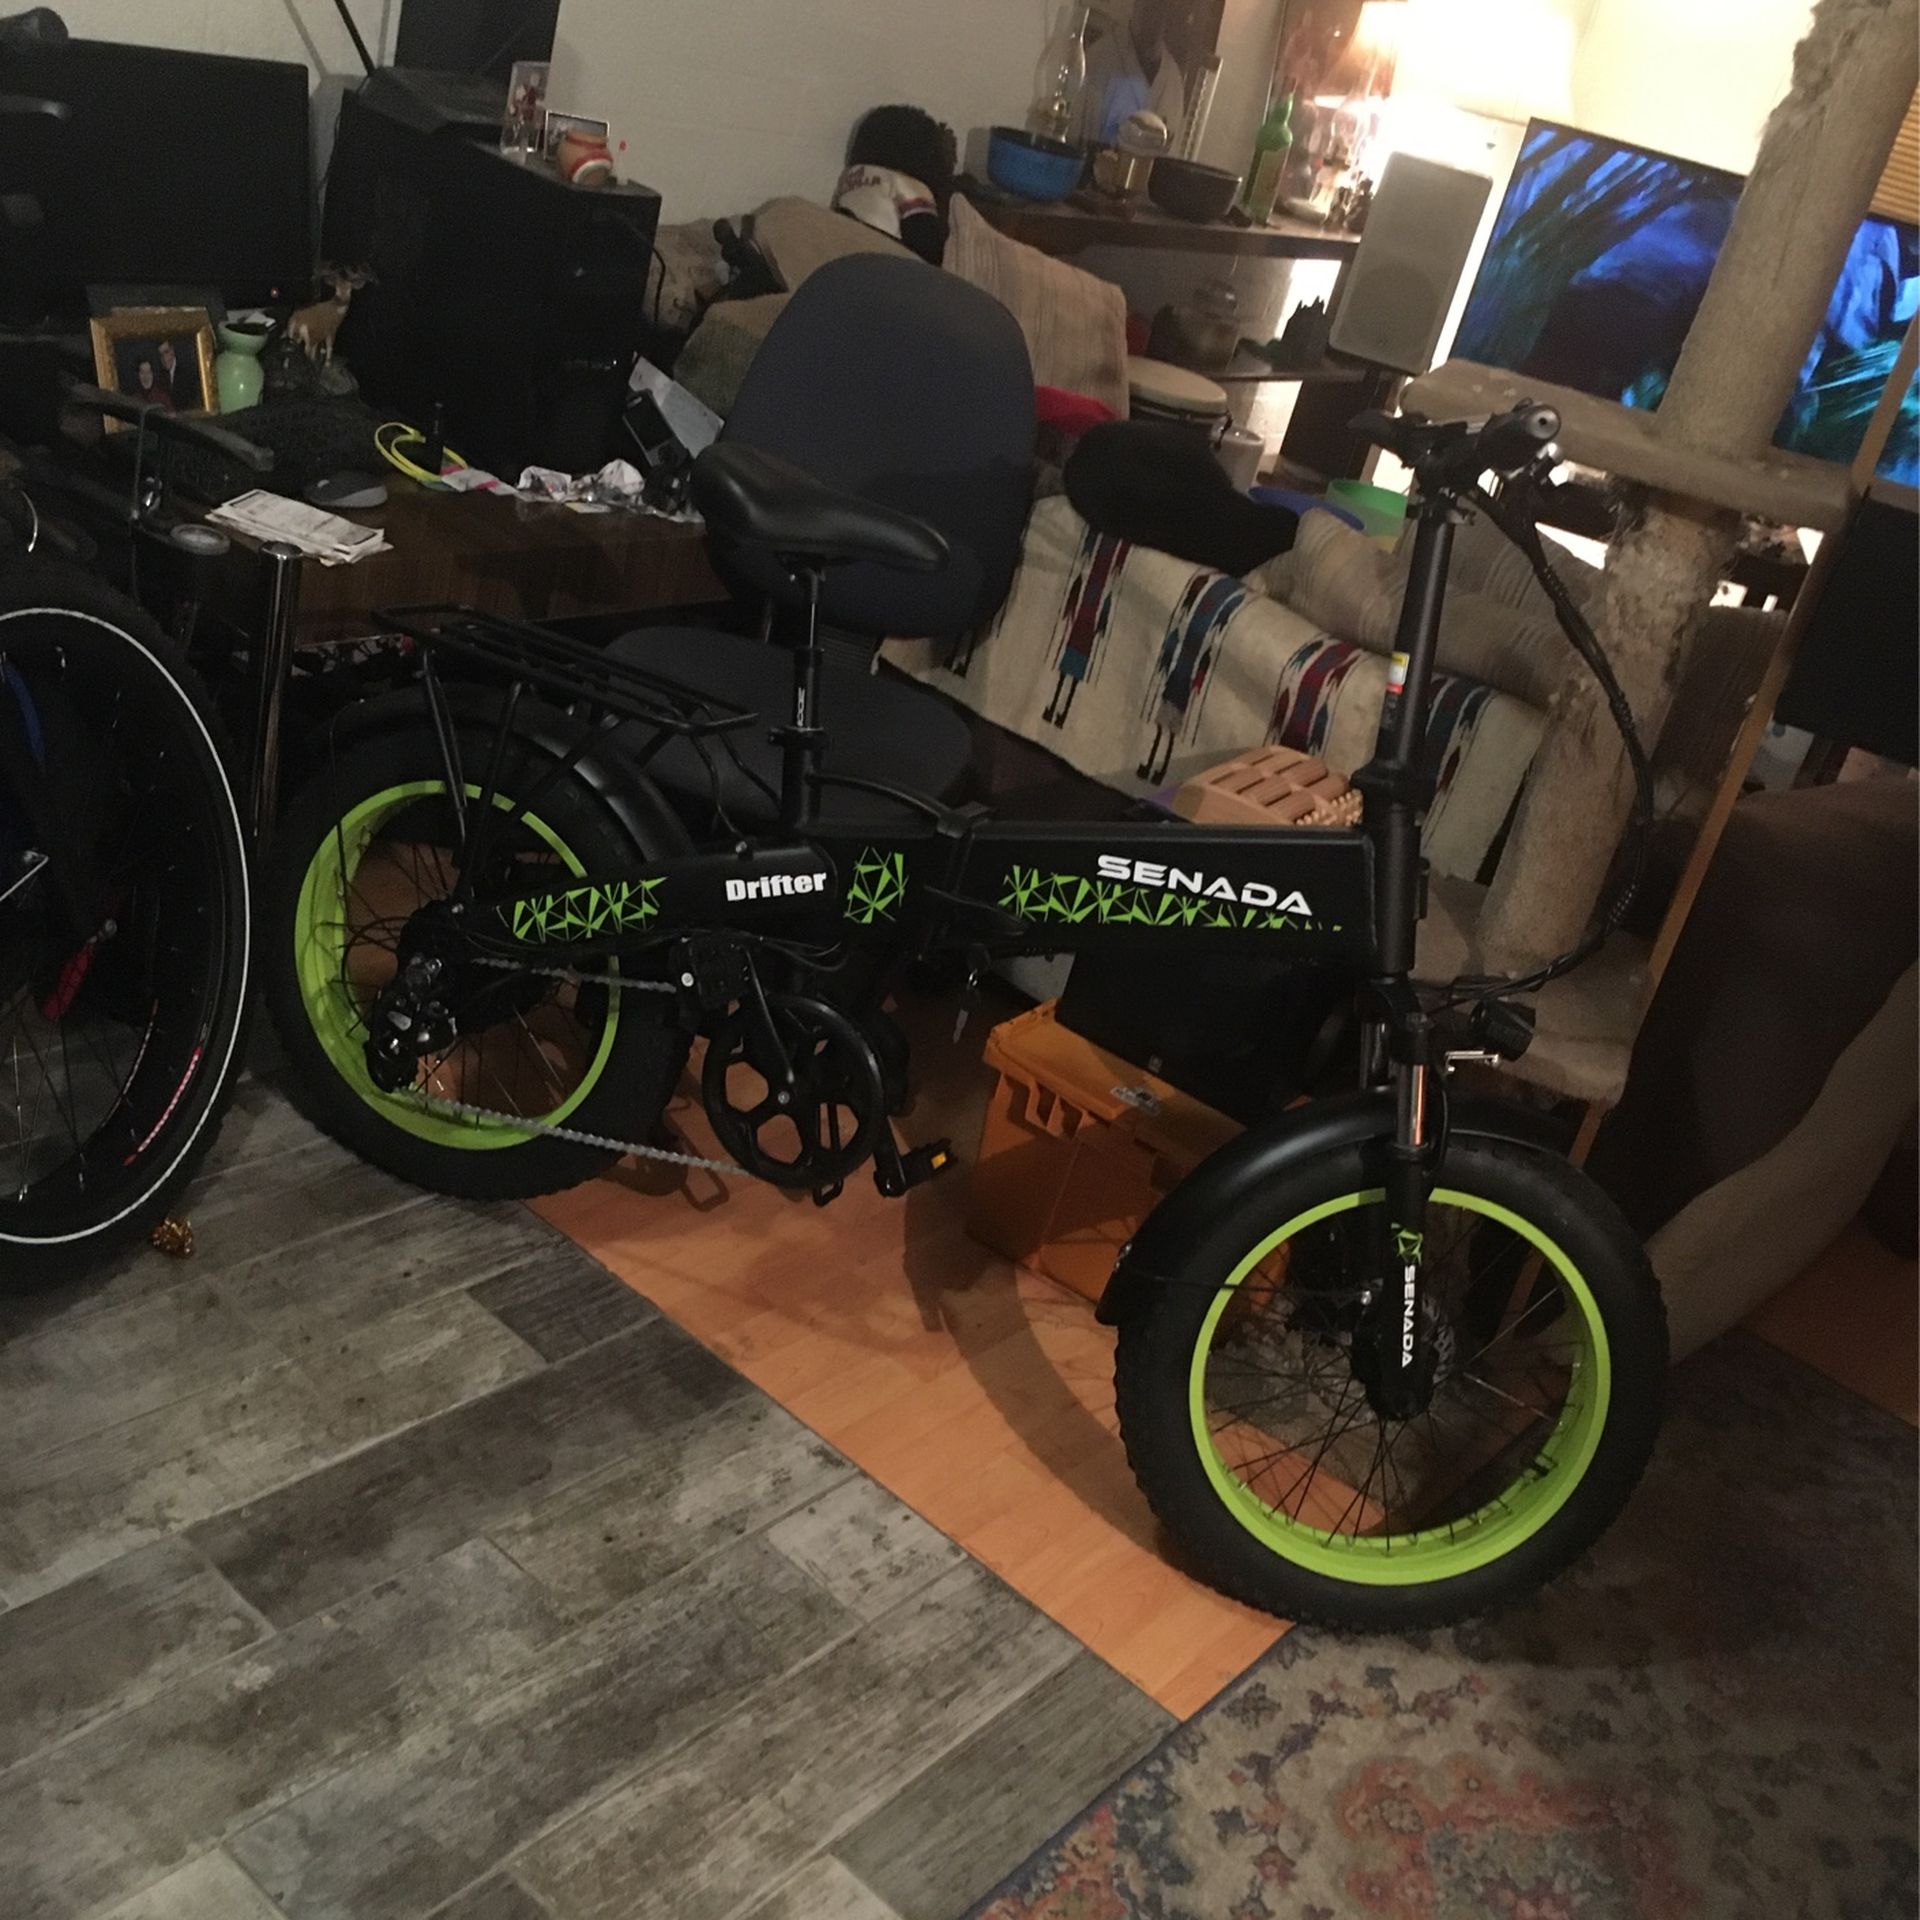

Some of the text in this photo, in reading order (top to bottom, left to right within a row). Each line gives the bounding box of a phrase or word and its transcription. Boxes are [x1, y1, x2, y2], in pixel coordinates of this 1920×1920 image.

[725, 872, 827, 902] Drifter
[1096, 854, 1312, 917] SENADA
[1401, 1264, 1416, 1368] SENADA
